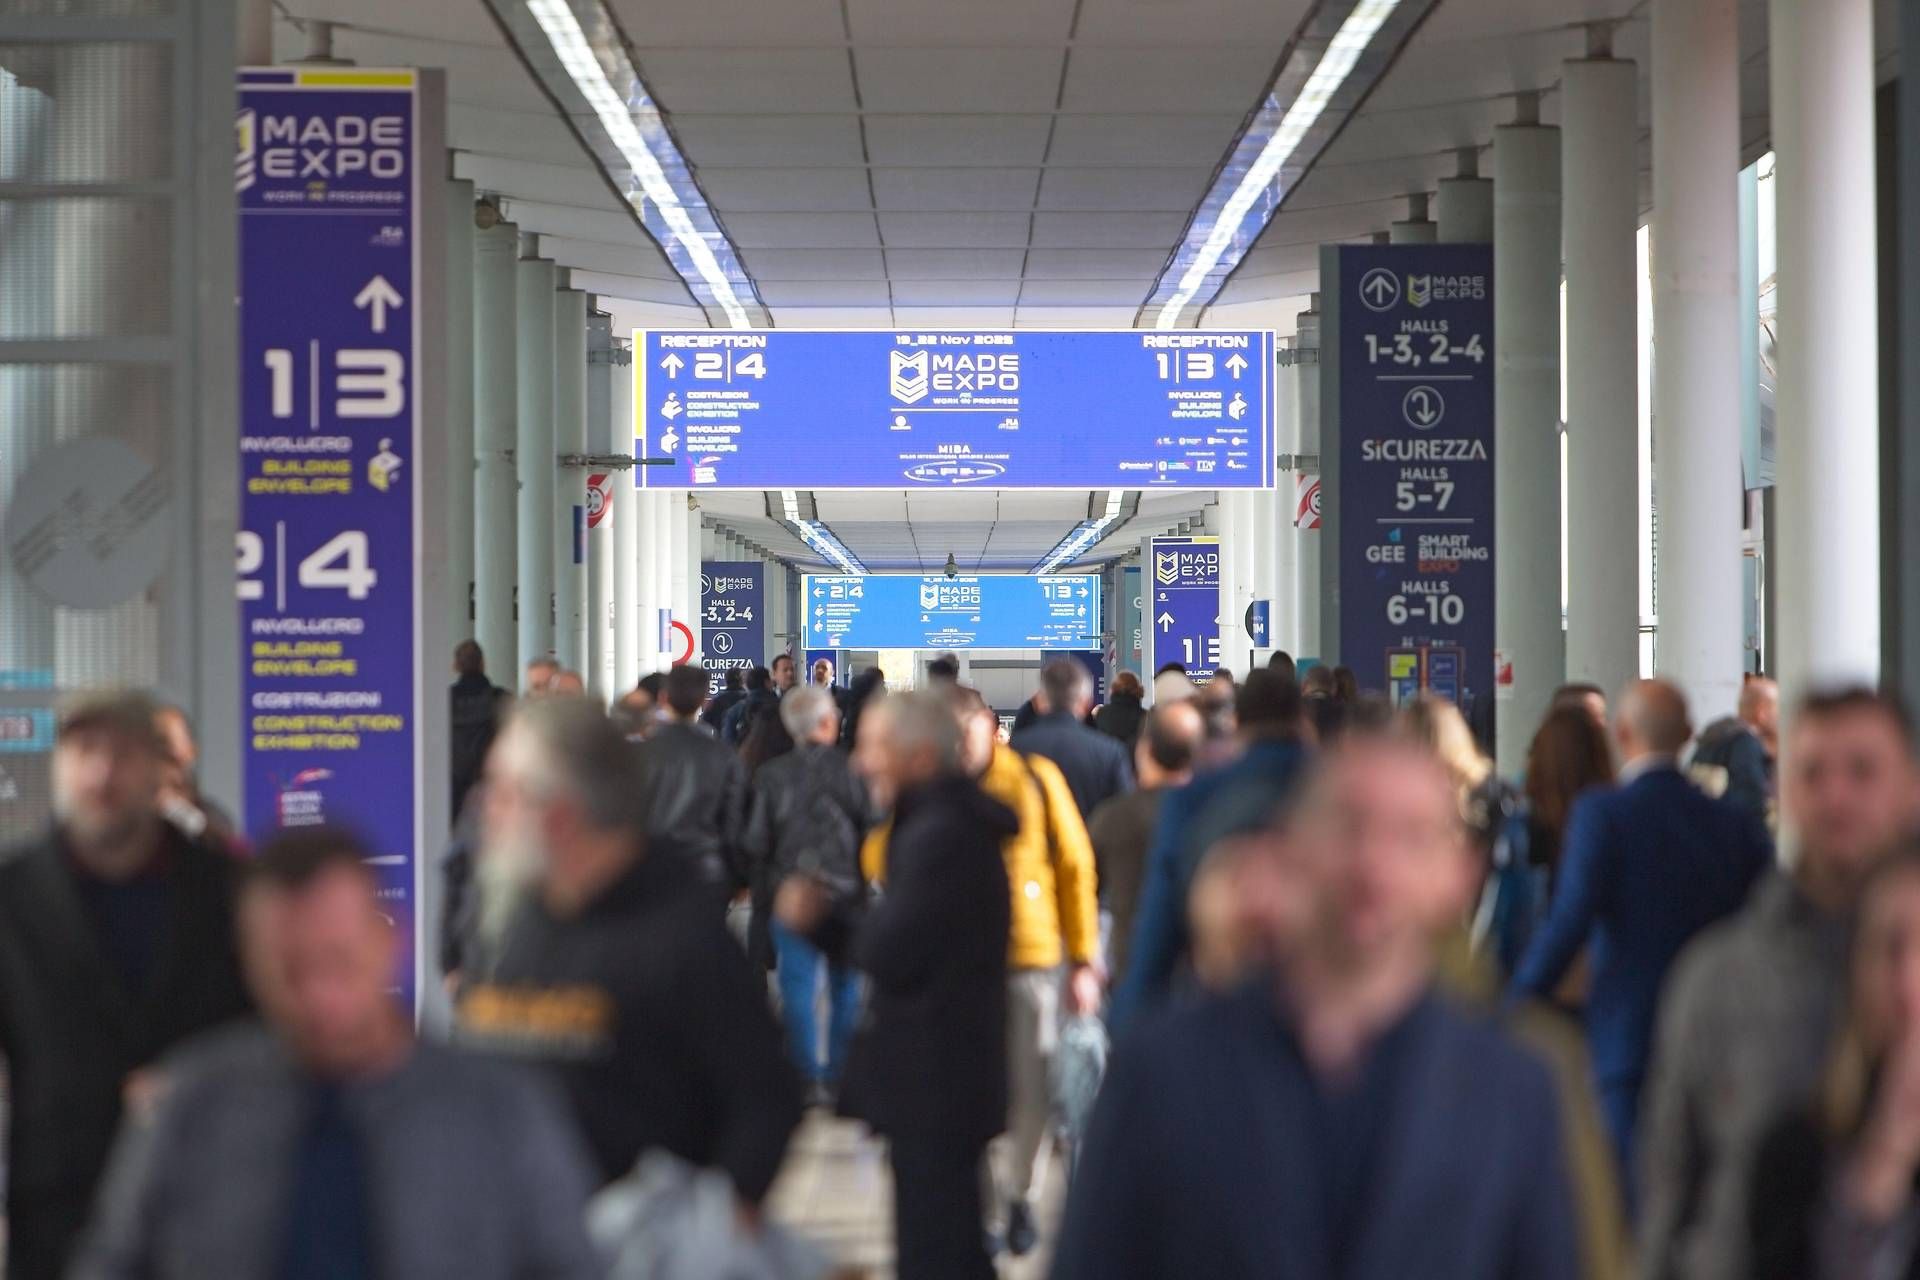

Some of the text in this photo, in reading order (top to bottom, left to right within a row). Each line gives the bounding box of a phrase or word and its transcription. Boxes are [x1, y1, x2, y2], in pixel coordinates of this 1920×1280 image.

[263, 116, 404, 145] MADE
[263, 148, 404, 178] EXPO
[1433, 276, 1485, 287] MADE
[1433, 288, 1485, 299] EXPO
[1401, 320, 1448, 332] HALLS
[660, 335, 766, 348] RECEPTION
[941, 335, 970, 345] Nov
[1143, 335, 1248, 348] RECEPTION
[1365, 334, 1485, 367] 1-3, 2-4
[695, 353, 767, 379] 2 4
[932, 354, 1019, 372] MADE
[1156, 353, 1214, 379] 1 3
[265, 349, 405, 418] 1 3
[932, 373, 1019, 391] EXPO
[938, 444, 971, 453] MIBA
[1401, 467, 1448, 480] HALLS
[1396, 482, 1455, 512] 5-7
[1418, 535, 1470, 547] SMART
[1181, 553, 1218, 564] MAD
[1366, 545, 1406, 563] GEE
[1418, 547, 1488, 561] BUILDING
[299, 530, 377, 599] 4
[1181, 566, 1218, 576] EXP
[1402, 581, 1449, 593] HALLS
[940, 595, 980, 603] EXPO
[701, 607, 753, 622] -3, 2-4
[1387, 594, 1465, 624] 6-10
[1182, 638, 1193, 664] 1
